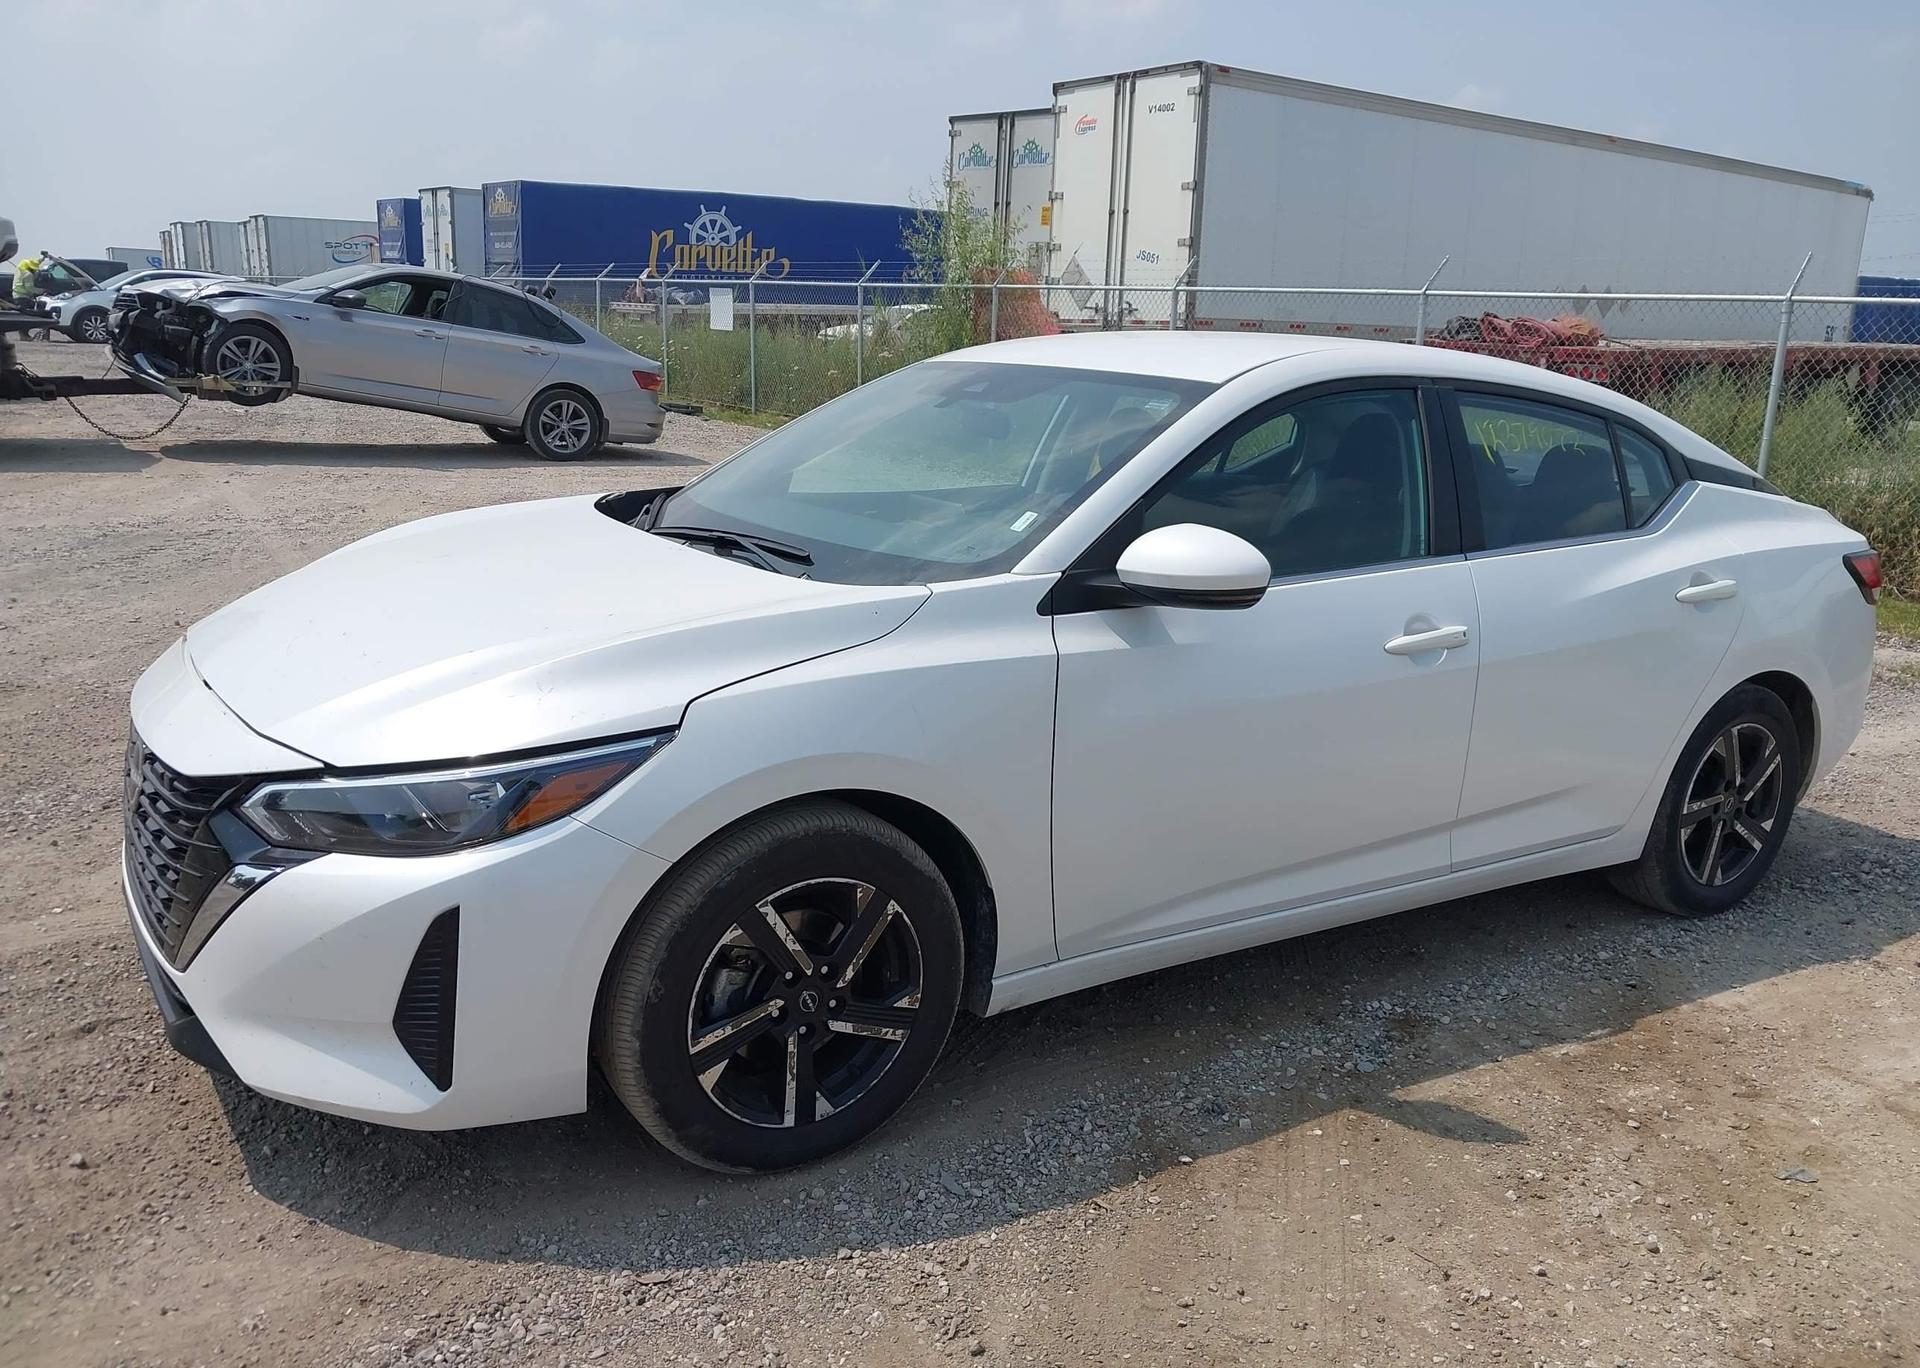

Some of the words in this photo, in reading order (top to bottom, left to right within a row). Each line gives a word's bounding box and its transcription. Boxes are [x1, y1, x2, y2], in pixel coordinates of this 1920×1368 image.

[1148, 102, 1176, 114] V14002
[648, 229, 790, 279] Corvette
[1136, 249, 1160, 265] JS051
